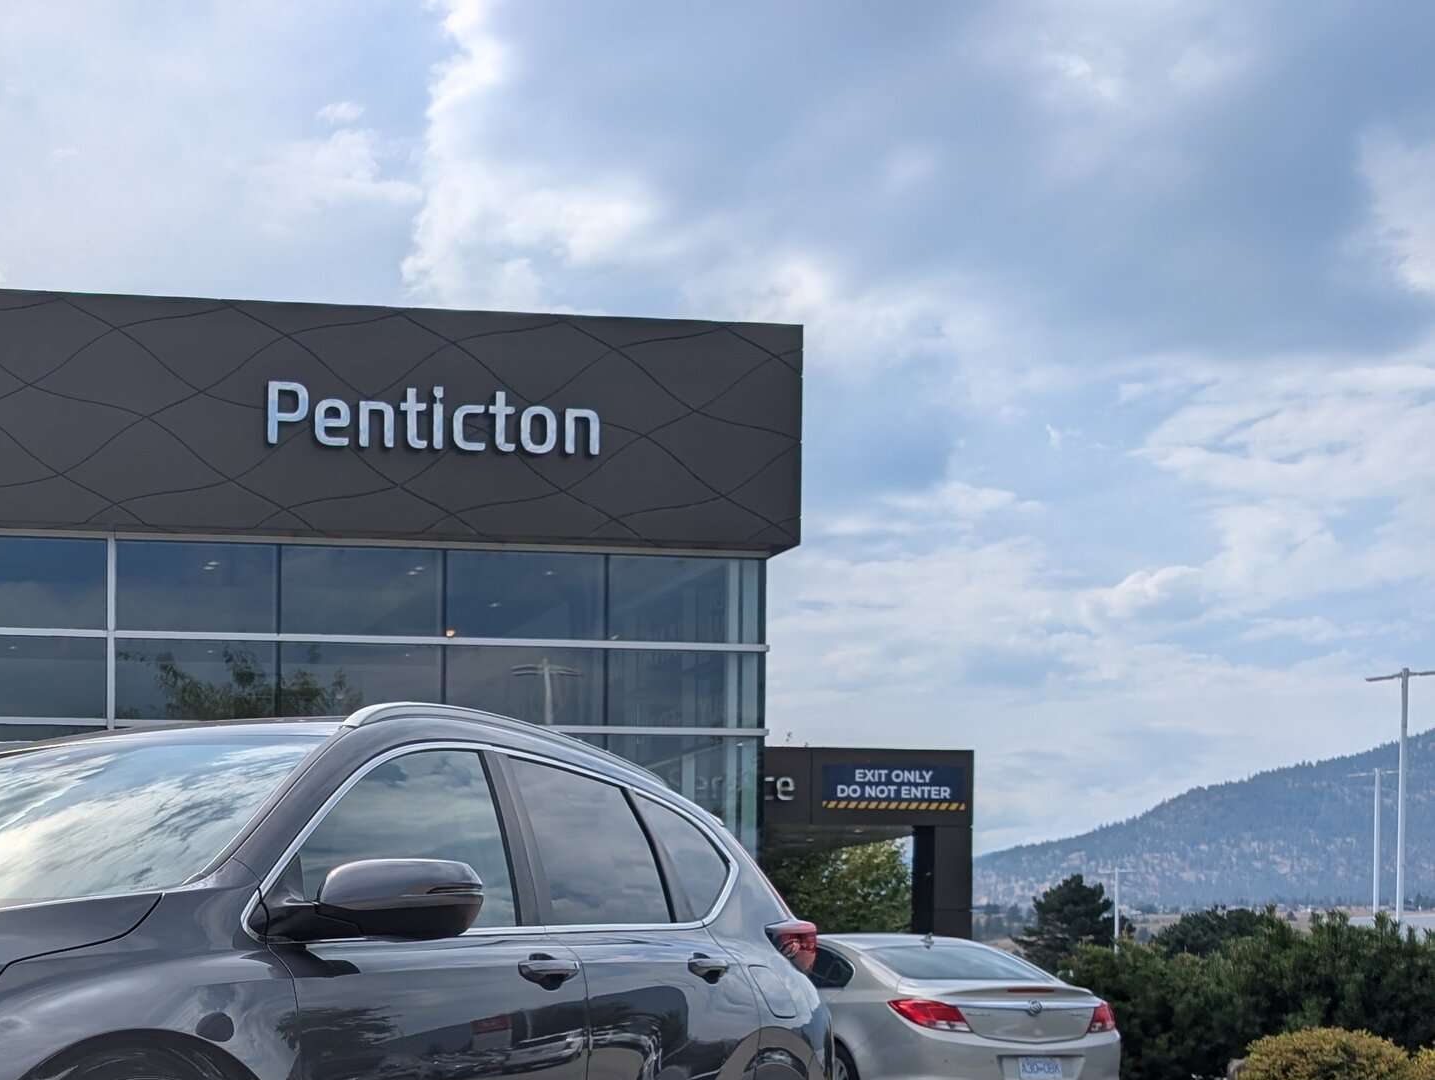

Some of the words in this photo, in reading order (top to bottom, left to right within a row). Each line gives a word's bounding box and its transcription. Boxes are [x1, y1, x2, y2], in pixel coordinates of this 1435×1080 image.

[267, 380, 600, 456] Penticton
[855, 769, 888, 782] EXIT
[891, 770, 933, 783] ONLY
[836, 785, 860, 798] DO
[865, 785, 897, 798] NOT
[901, 786, 951, 799] ENTER
